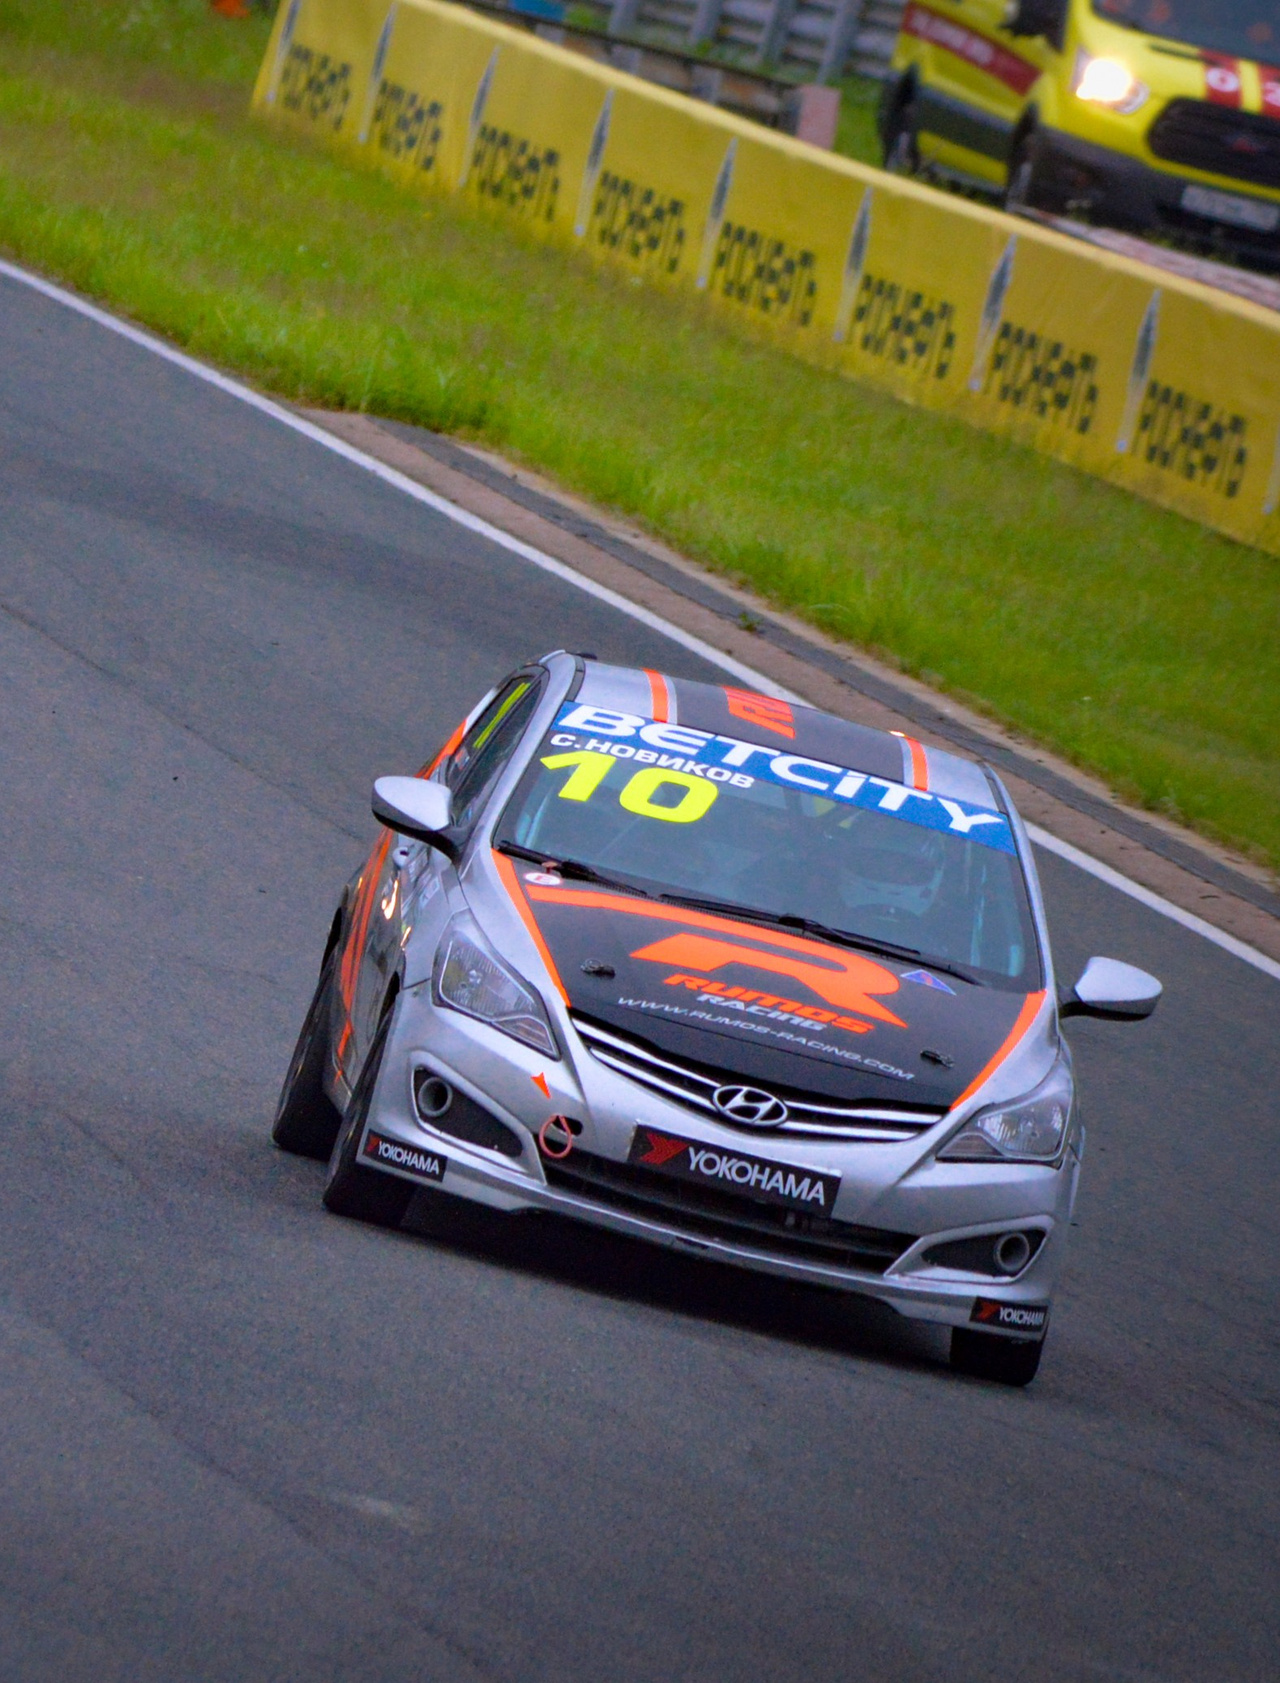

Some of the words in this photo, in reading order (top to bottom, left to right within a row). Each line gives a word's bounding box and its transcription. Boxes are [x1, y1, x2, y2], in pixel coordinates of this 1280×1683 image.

[539, 750, 719, 823] 10
[557, 704, 1004, 833] BETCITY
[377, 1140, 441, 1176] YOKOHAMA
[686, 1146, 826, 1206] YOKOHAMA
